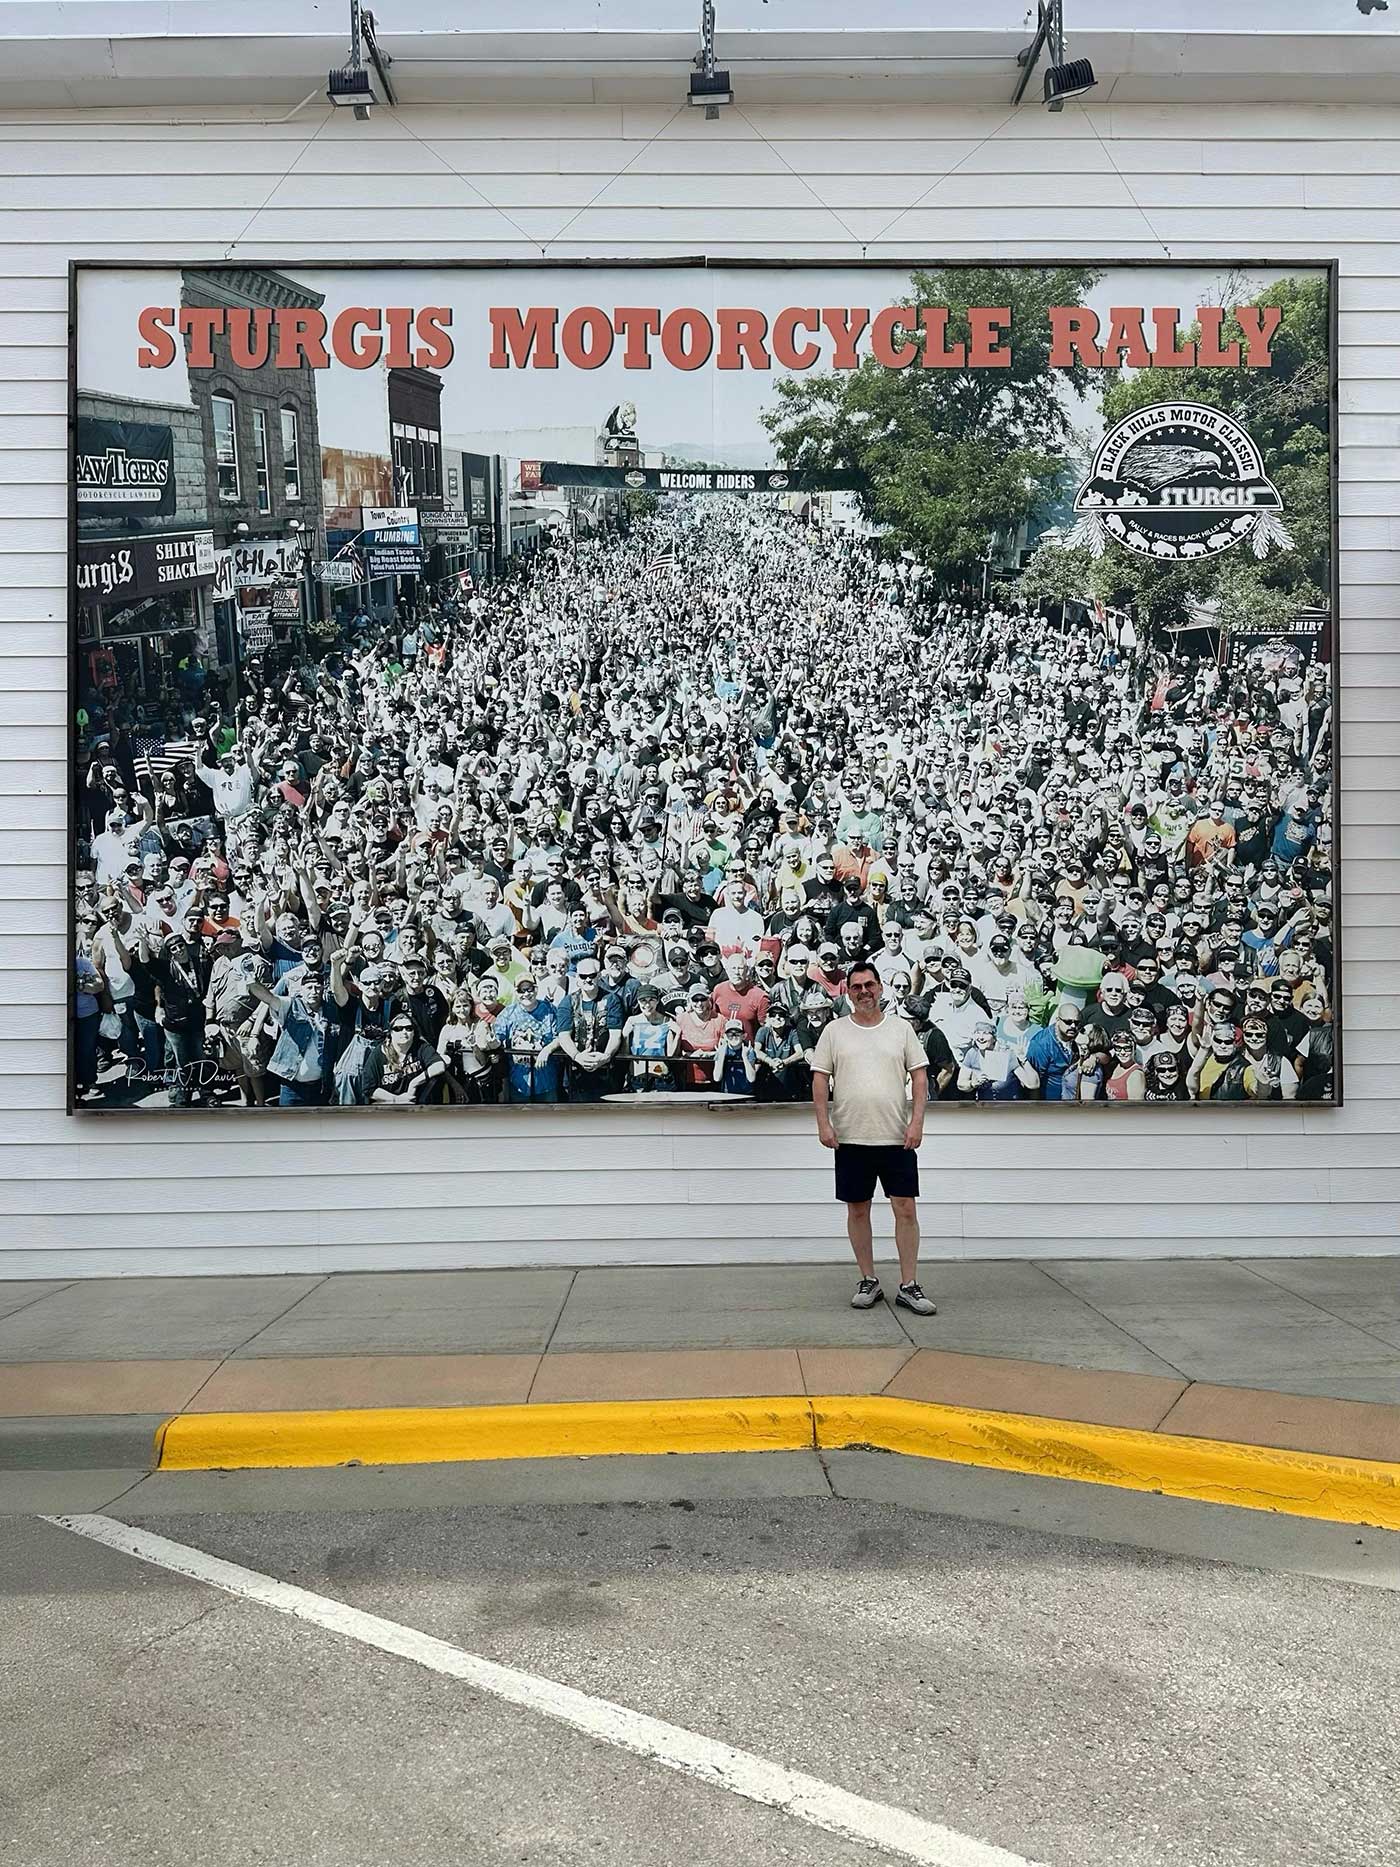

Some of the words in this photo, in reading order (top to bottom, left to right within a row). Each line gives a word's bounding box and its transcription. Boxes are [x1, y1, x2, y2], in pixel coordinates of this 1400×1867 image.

[138, 306, 454, 370] STURGIS
[489, 306, 1012, 371] MOTORCYCLE
[1049, 306, 1282, 368] RALLY
[1101, 432, 1130, 472] BLACK
[1127, 410, 1166, 435] HILLS
[1170, 409, 1217, 429] MOTOR
[1218, 424, 1255, 471] CLASSIC
[659, 473, 712, 489] WELCOME
[716, 474, 756, 489] RIDERS
[1159, 486, 1270, 506] STURGIS
[370, 511, 386, 520] Town
[386, 516, 410, 525] Country
[374, 530, 415, 543] PLUMBING
[1129, 520, 1149, 534] RALLY
[1154, 533, 1178, 541] RACES
[1179, 533, 1201, 541] BLACK
[1201, 525, 1220, 538] HILLS
[156, 541, 195, 560] SHIRT
[158, 562, 197, 582] SHACK
[272, 591, 296, 600] RUSS
[1289, 621, 1324, 631] SHIRT
[184, 1059, 245, 1085] Davis
